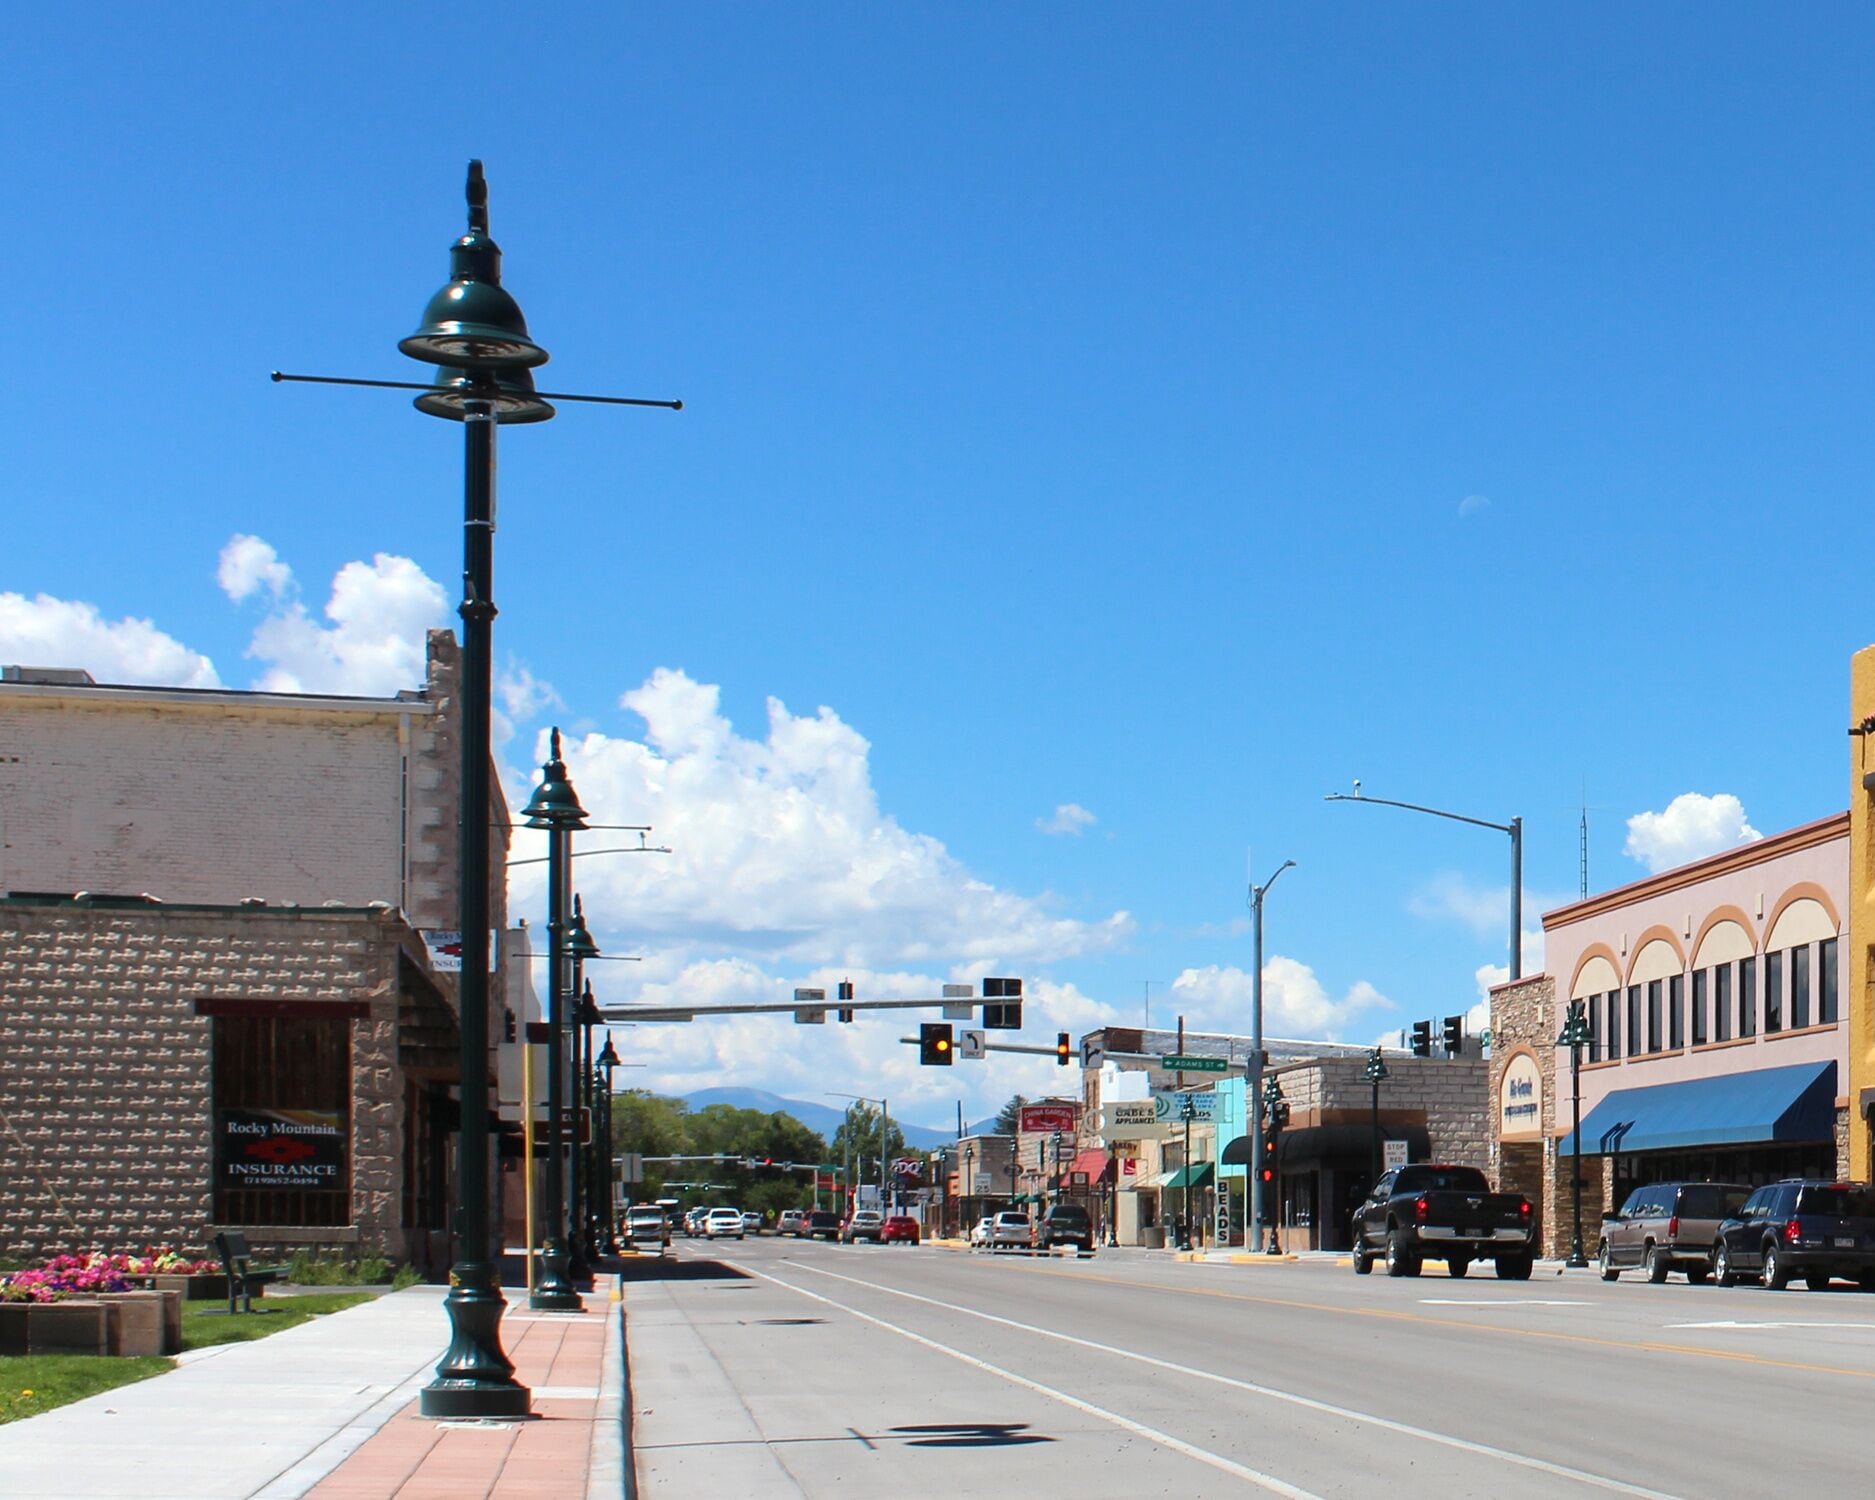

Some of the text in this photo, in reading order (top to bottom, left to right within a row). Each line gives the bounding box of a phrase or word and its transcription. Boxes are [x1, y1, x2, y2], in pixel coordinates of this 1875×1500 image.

[1175, 1060, 1215, 1069] ADAMS ST
[1024, 1109, 1072, 1119] CHINA GARDEN
[1115, 1117, 1155, 1125] APPLIANCES
[227, 1121, 337, 1137] Rocky Mountain
[1108, 1142, 1137, 1152] BKERY
[228, 1163, 337, 1176] INSURANCE
[897, 1161, 921, 1175] DQ
[976, 1184, 990, 1193] 25
[1218, 1181, 1229, 1242] BEADS
